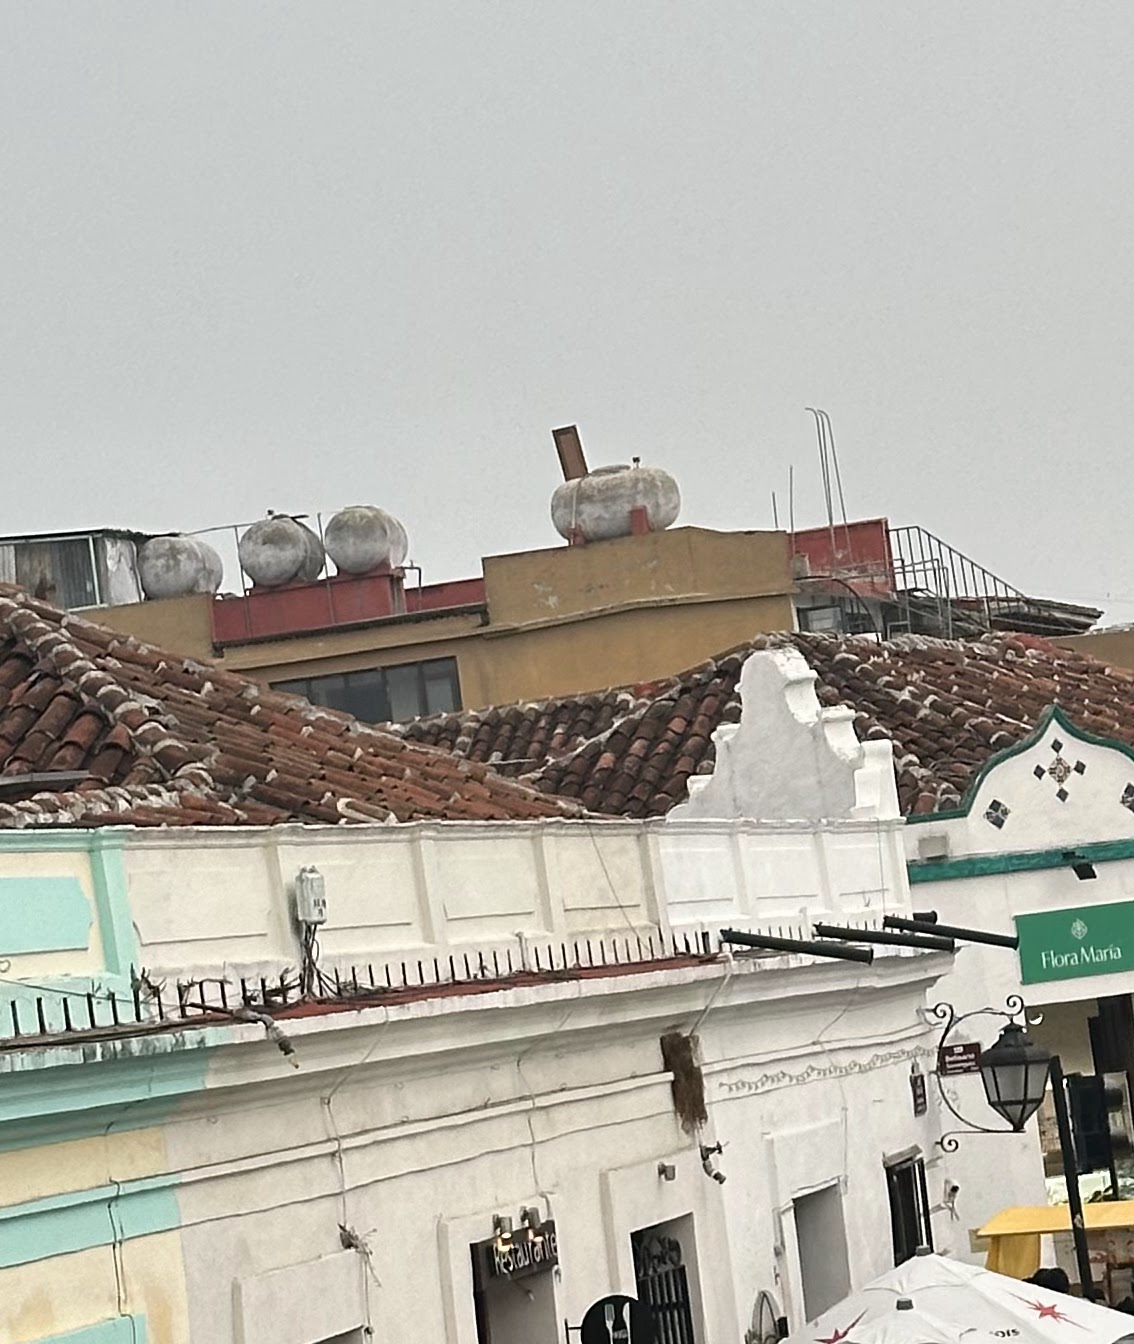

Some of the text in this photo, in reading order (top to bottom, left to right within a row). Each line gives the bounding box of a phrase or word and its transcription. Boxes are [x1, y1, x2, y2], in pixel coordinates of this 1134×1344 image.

[1041, 944, 1122, 969] Flora María
[493, 1231, 557, 1275] Restaurante
